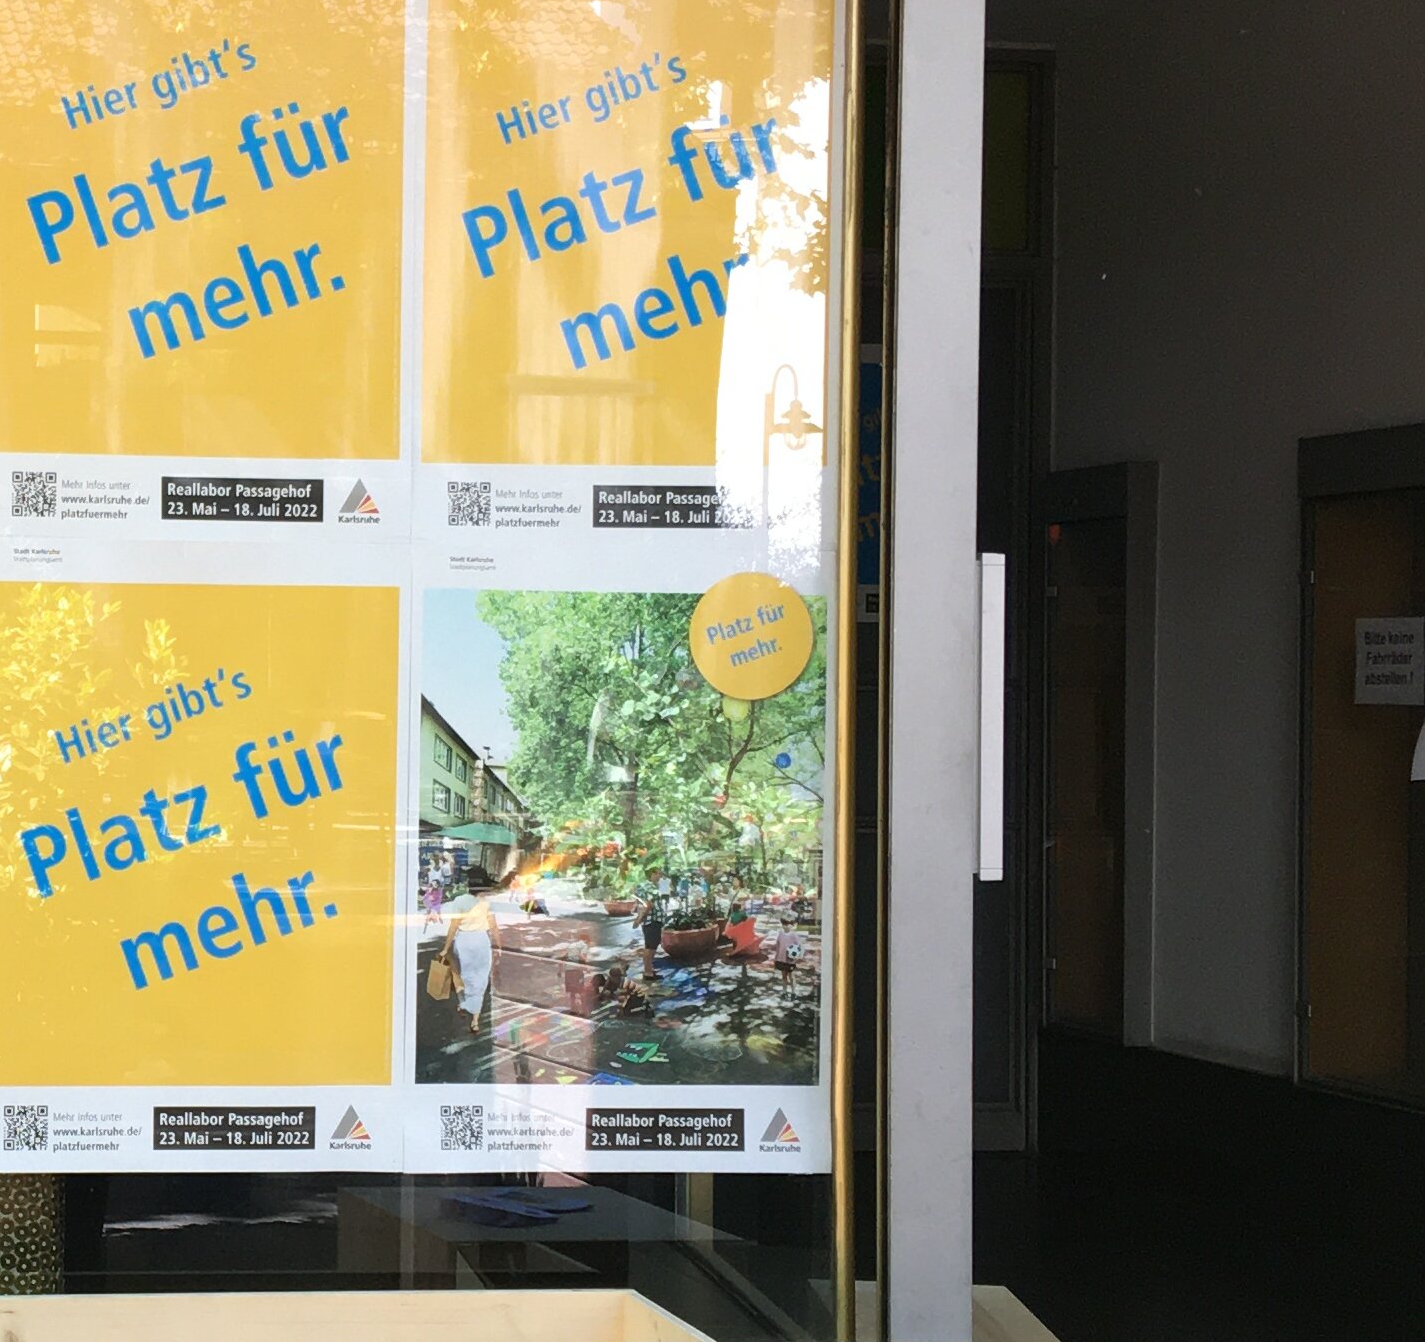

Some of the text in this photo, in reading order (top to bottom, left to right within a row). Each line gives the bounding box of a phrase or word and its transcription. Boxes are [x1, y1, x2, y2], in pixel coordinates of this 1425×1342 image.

[61, 79, 141, 129] Hier
[496, 96, 574, 143] Hier
[27, 102, 350, 264] Platz für
[462, 114, 777, 277] Platz für
[129, 244, 344, 358] mehr.
[61, 479, 131, 490] Mehr Infos unter
[167, 483, 312, 500] Reallabor Passagehof
[61, 494, 150, 506] www.karlsruhe.de/
[495, 489, 563, 499] Mehr Infos unter
[599, 491, 662, 504] Reallabor
[61, 509, 128, 521] platzfuermehr
[167, 502, 188, 516] 23.
[192, 502, 217, 516] Mai
[233, 503, 254, 517] 18.
[257, 503, 280, 517] Juli
[284, 504, 318, 518] 2022
[495, 504, 581, 514] www.karlsruhe.de/
[338, 516, 380, 524] Karlsruhe
[495, 518, 560, 529] platzfuermehr
[599, 510, 619, 523] 23.
[623, 511, 647, 523] Mai
[664, 511, 684, 523] 18.
[687, 511, 710, 524] Juli
[706, 604, 784, 645] Platz für
[1364, 631, 1414, 645] Bitte keine
[730, 637, 783, 667] mehr.
[1366, 652, 1413, 665] Fahrräder
[1365, 672, 1407, 685] abstellen
[55, 714, 134, 764] Hier
[20, 730, 344, 898] Platz für
[120, 872, 338, 989] mehr.
[52, 1112, 123, 1122] Mehr Infos unter
[159, 1113, 304, 1129] Reallabor Passagehof
[591, 1114, 732, 1130] Reallabor Passagehof
[52, 1126, 142, 1137] www.karlsruhe.de/
[487, 1126, 575, 1138] www.karlsruhe.de/
[159, 1132, 180, 1146] 23.
[184, 1132, 209, 1145] Mai
[226, 1133, 247, 1146] 18.
[250, 1132, 273, 1146] Juli
[276, 1132, 310, 1146] 2022
[591, 1133, 612, 1147] 23.
[615, 1133, 640, 1147] Mai
[657, 1134, 677, 1147] 18.
[679, 1134, 702, 1147] Juli
[705, 1134, 739, 1147] 2022
[52, 1141, 120, 1153] platzfuermehr
[329, 1142, 372, 1151] Karlsruhe
[487, 1141, 553, 1153] platzfuermehr
[759, 1144, 801, 1153] Karlsruhe
